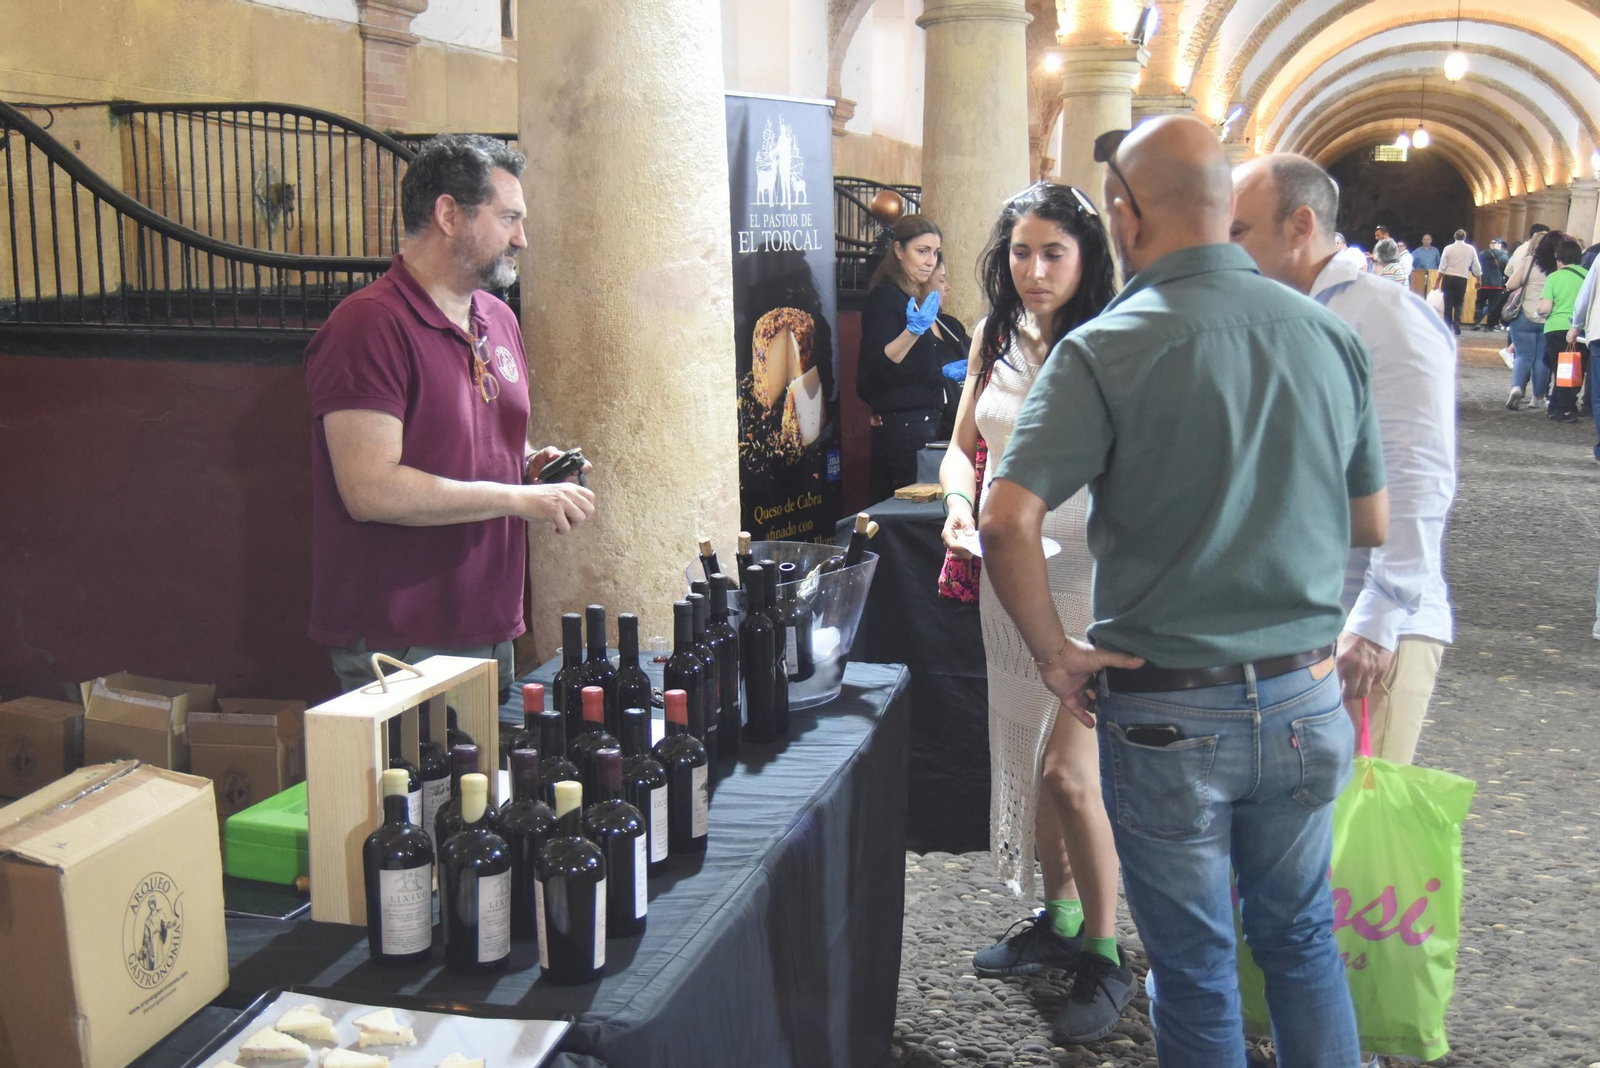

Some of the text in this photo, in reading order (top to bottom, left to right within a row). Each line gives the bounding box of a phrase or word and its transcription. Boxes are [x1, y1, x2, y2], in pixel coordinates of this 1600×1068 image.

[750, 213, 813, 228] EL PASTOR DE
[737, 229, 823, 254] EL TORCAL
[754, 491, 822, 525] Queso de Cabra
[765, 519, 814, 542] afinado con
[130, 876, 171, 915] ARQUEO
[127, 923, 182, 987] GASTRONOMIA
